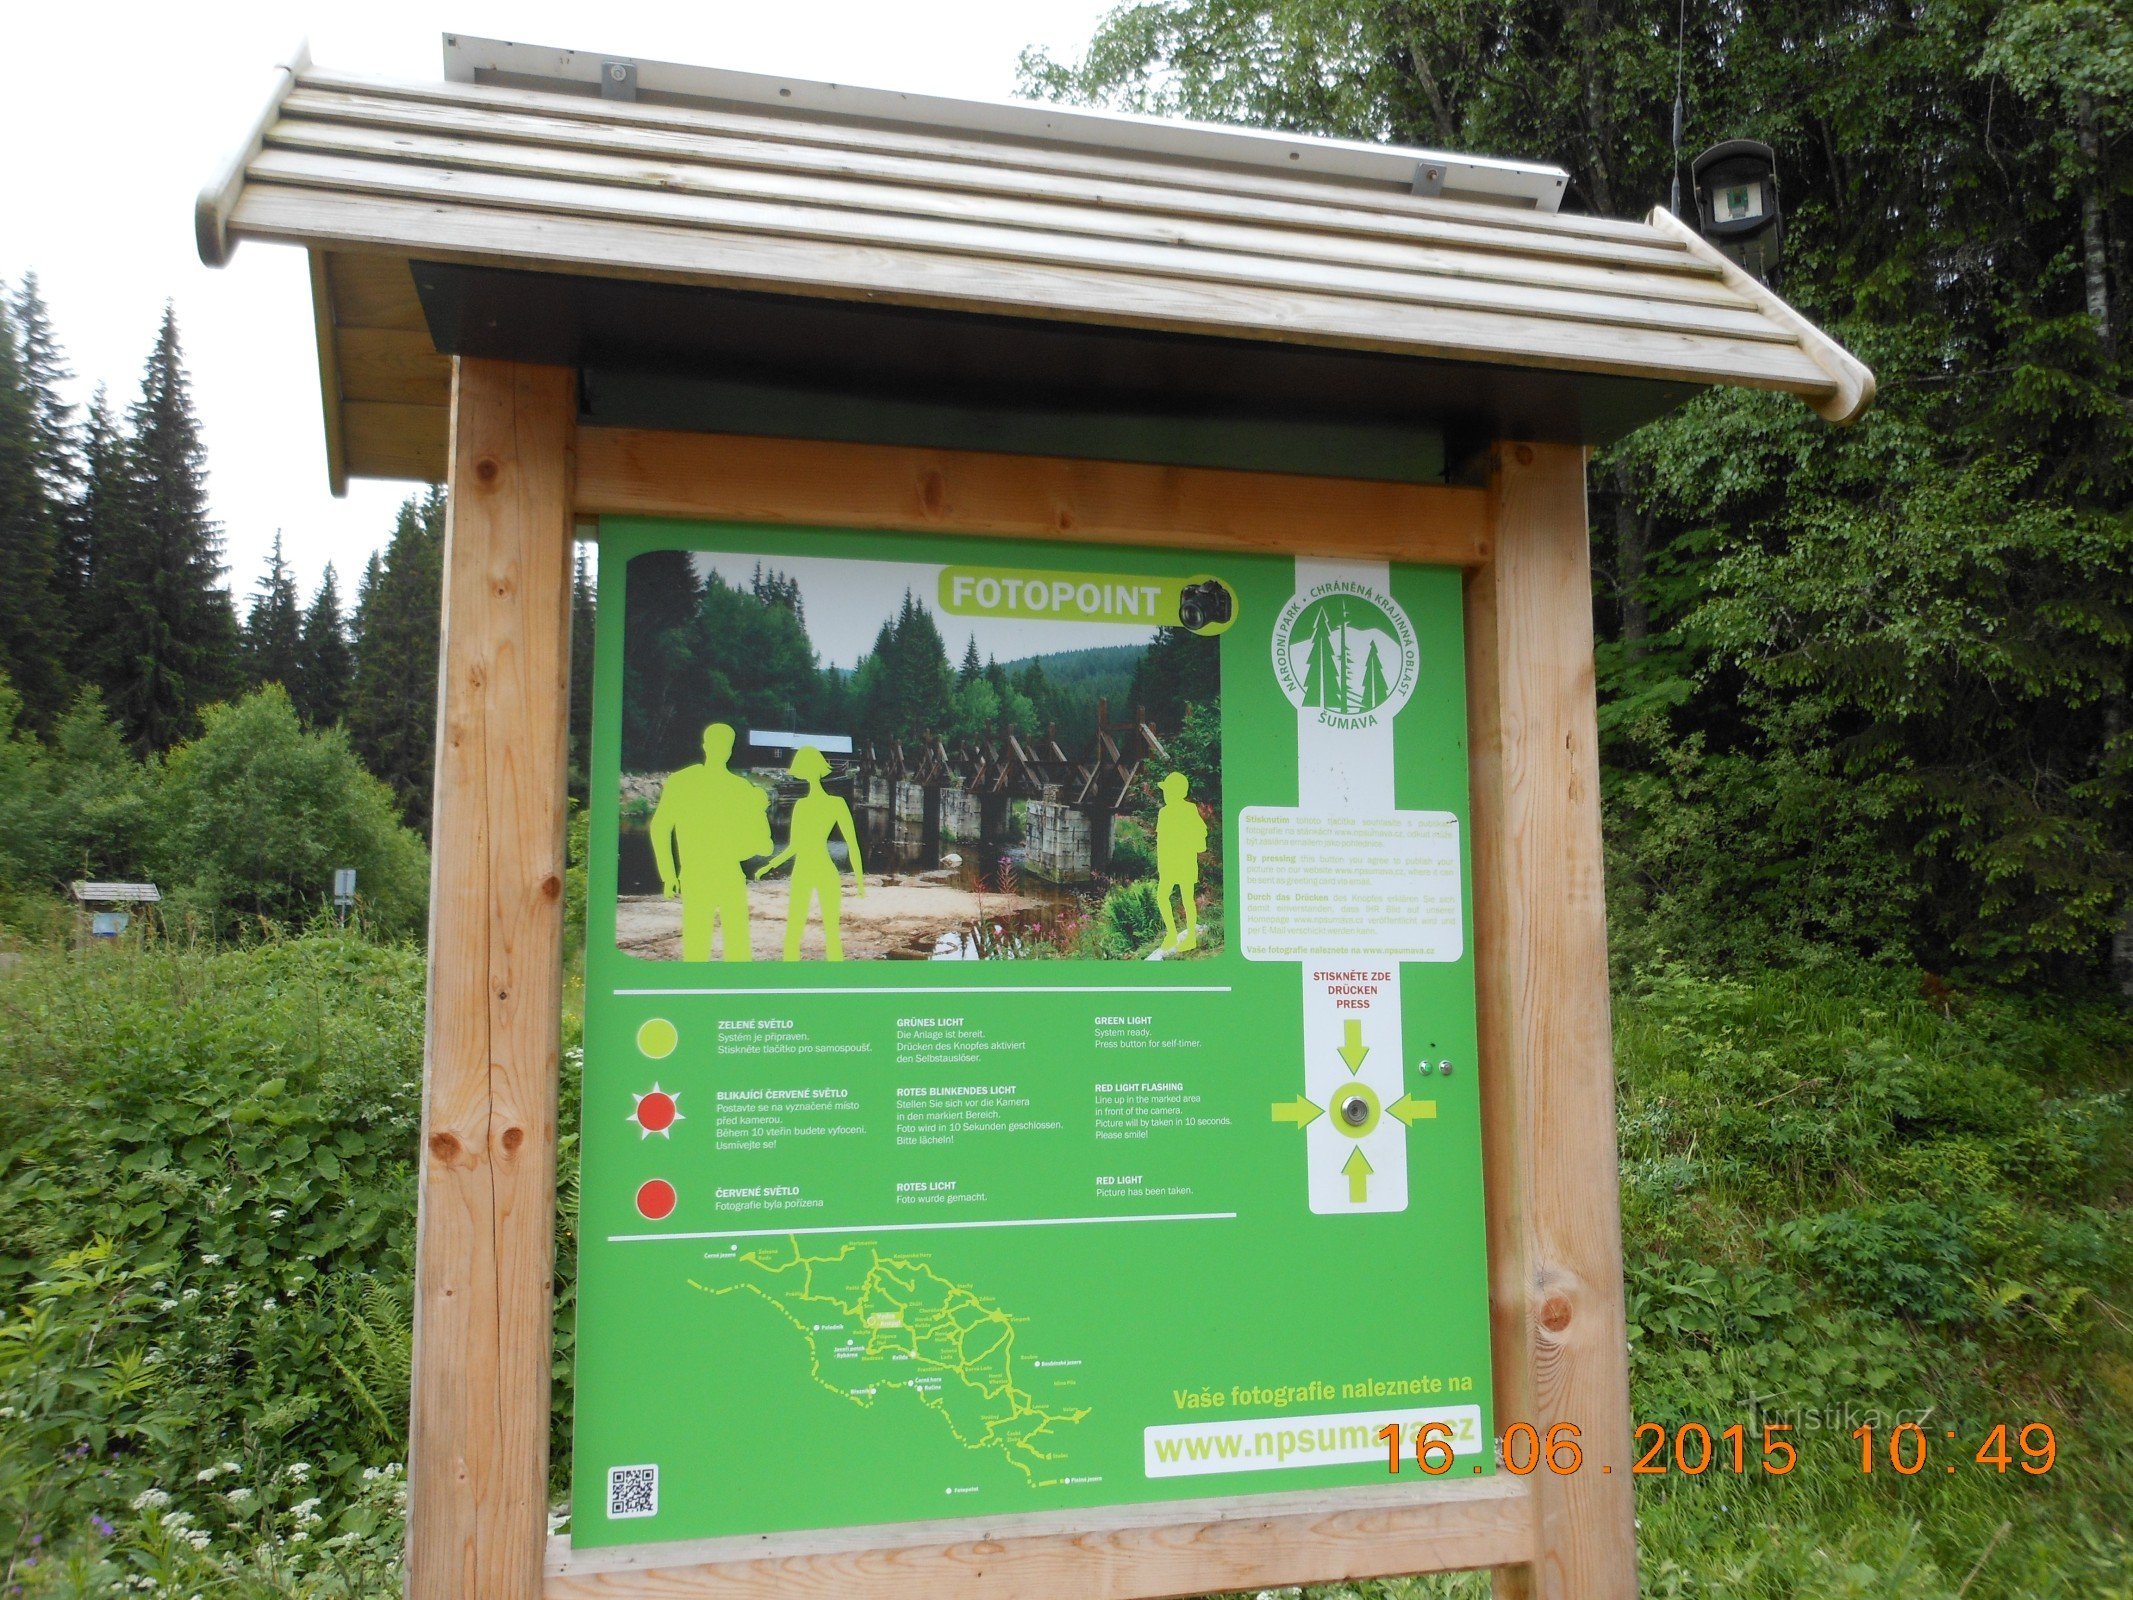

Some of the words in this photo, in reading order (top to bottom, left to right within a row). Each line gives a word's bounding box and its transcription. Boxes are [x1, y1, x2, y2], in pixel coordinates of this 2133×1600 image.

[1310, 581, 1373, 598] CHRÁNĚNÁ
[953, 576, 1161, 617] FOTOPOINT
[1280, 605, 1301, 632] PARK
[1374, 594, 1412, 647] KRAJINNÁ
[1277, 634, 1297, 692] NÁRODNÍ
[1398, 651, 1414, 698] OBLAST
[1318, 710, 1378, 730] ŠUMAVA
[1314, 970, 1368, 981] STISKNĚTE
[1371, 972, 1391, 981] ZDE
[1328, 984, 1378, 994] DRÜCKEN
[1336, 1000, 1370, 1008] PRESS
[718, 1019, 755, 1029] ZELENÉ
[757, 1019, 794, 1029] SVĚTLO
[897, 1017, 935, 1027] GRÜNES
[938, 1018, 964, 1026] LICHT
[1094, 1017, 1125, 1025] GREEN
[718, 1033, 751, 1043] Systém
[753, 1033, 762, 1044] je
[764, 1032, 810, 1042] připraven.
[897, 1031, 912, 1039] Die
[913, 1031, 943, 1040] Anlage
[945, 1030, 956, 1038] ist
[958, 1030, 985, 1038] bereit.
[1094, 1028, 1125, 1038] System
[1127, 1027, 1152, 1037] ready.
[718, 1045, 761, 1054] Stiskněte
[763, 1044, 797, 1053] tlačítko
[798, 1046, 813, 1054] pro
[815, 1043, 873, 1053] samospoušť.
[897, 1043, 933, 1051] Drücken
[935, 1042, 951, 1050] des
[953, 1042, 989, 1050] Knopfes
[1095, 1040, 1117, 1048] Press
[1120, 1040, 1146, 1048] button
[1149, 1039, 1160, 1047] for
[1161, 1039, 1202, 1047] self-timer.
[896, 1054, 913, 1063] den
[915, 1053, 981, 1063] Selbstauslöser.
[897, 1088, 927, 1096] ROTES
[929, 1087, 988, 1096] BLINKENDES
[990, 1086, 1016, 1094] LICHT
[1095, 1084, 1113, 1092] RED
[1115, 1084, 1139, 1092] LIGHT
[1141, 1083, 1183, 1091] FLASHING
[717, 1089, 763, 1100] BLIKAJÍCÍ
[765, 1088, 810, 1099] ČERVENÉ
[812, 1088, 848, 1098] SVĚTLO
[896, 1100, 927, 1109] Stellen
[929, 1099, 943, 1108] Sie
[945, 1099, 963, 1108] sich
[980, 1098, 994, 1107] die
[996, 1098, 1030, 1106] Kamera
[1095, 1095, 1113, 1104] Line
[1114, 1097, 1125, 1105] up
[1136, 1095, 1149, 1103] the
[1151, 1095, 1181, 1103] marked
[716, 1104, 756, 1112] Postavte
[785, 1102, 832, 1112] vyznačené
[835, 1101, 859, 1110] místo
[1104, 1107, 1124, 1115] front
[1125, 1106, 1134, 1115] of
[1135, 1107, 1149, 1115] the
[907, 1112, 924, 1120] den
[926, 1111, 963, 1120] markiert
[965, 1110, 1000, 1119] Bereich.
[716, 1116, 737, 1126] před
[1095, 1119, 1124, 1127] Picture
[1125, 1119, 1138, 1127] will
[1140, 1118, 1150, 1128] by
[1151, 1118, 1173, 1127] taken
[1175, 1118, 1183, 1126] in
[1185, 1117, 1196, 1126] 10
[716, 1129, 749, 1137] Během
[752, 1128, 764, 1136] 10
[766, 1127, 792, 1136] vteřin
[794, 1126, 826, 1135] budete
[828, 1125, 867, 1136] vyfoceni.
[896, 1124, 916, 1133] Foto
[918, 1124, 936, 1132] wird
[950, 1123, 961, 1131] 10
[963, 1122, 1006, 1131] Sekunden
[1008, 1121, 1063, 1132] geschlossen.
[1095, 1131, 1122, 1139] Please
[1124, 1130, 1148, 1139] smile!
[896, 1136, 917, 1145] Bitte
[919, 1136, 954, 1144] lächeln!
[1096, 1176, 1115, 1185] RED
[1117, 1176, 1143, 1184] LIGHT
[715, 1187, 761, 1198] ČERVENÉ
[763, 1185, 800, 1196] SVĚTLO
[897, 1183, 927, 1191] ROTES
[929, 1182, 956, 1190] LICHT
[1096, 1188, 1126, 1196] Picture
[1128, 1188, 1143, 1196] has
[1145, 1188, 1166, 1196] been
[1168, 1187, 1193, 1195] taken.
[896, 1195, 916, 1204] Foto
[917, 1194, 945, 1203] wurde
[947, 1193, 988, 1204] gemacht.
[715, 1201, 761, 1212] Fotografie
[764, 1200, 782, 1210] byla
[784, 1198, 824, 1209] pořízena
[1173, 1387, 1225, 1410] Vaše
[1231, 1381, 1335, 1408] fotografie
[1342, 1375, 1442, 1399] naleznete
[1448, 1376, 1473, 1392] na
